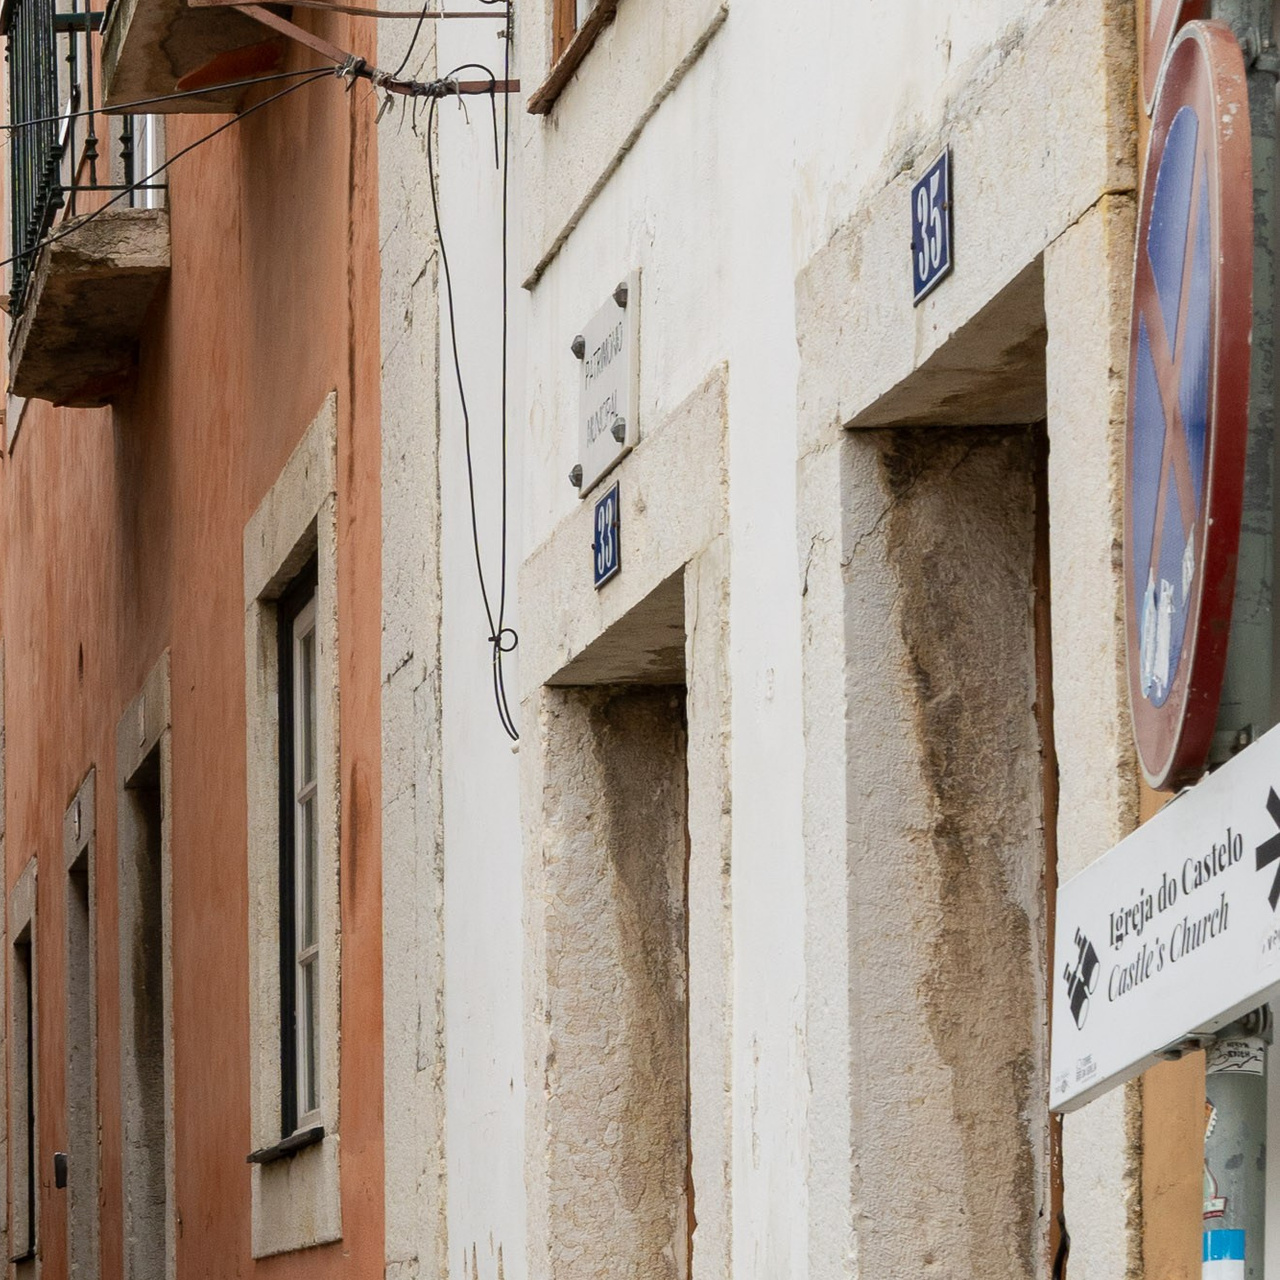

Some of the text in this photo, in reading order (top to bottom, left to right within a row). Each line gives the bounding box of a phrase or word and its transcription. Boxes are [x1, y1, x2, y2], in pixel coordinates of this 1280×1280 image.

[916, 169, 942, 282] 35
[597, 497, 613, 576] 33
[1109, 827, 1244, 951] Igreja do Castelo
[1107, 935, 1165, 1003] Castle's
[1169, 892, 1230, 963] Church
